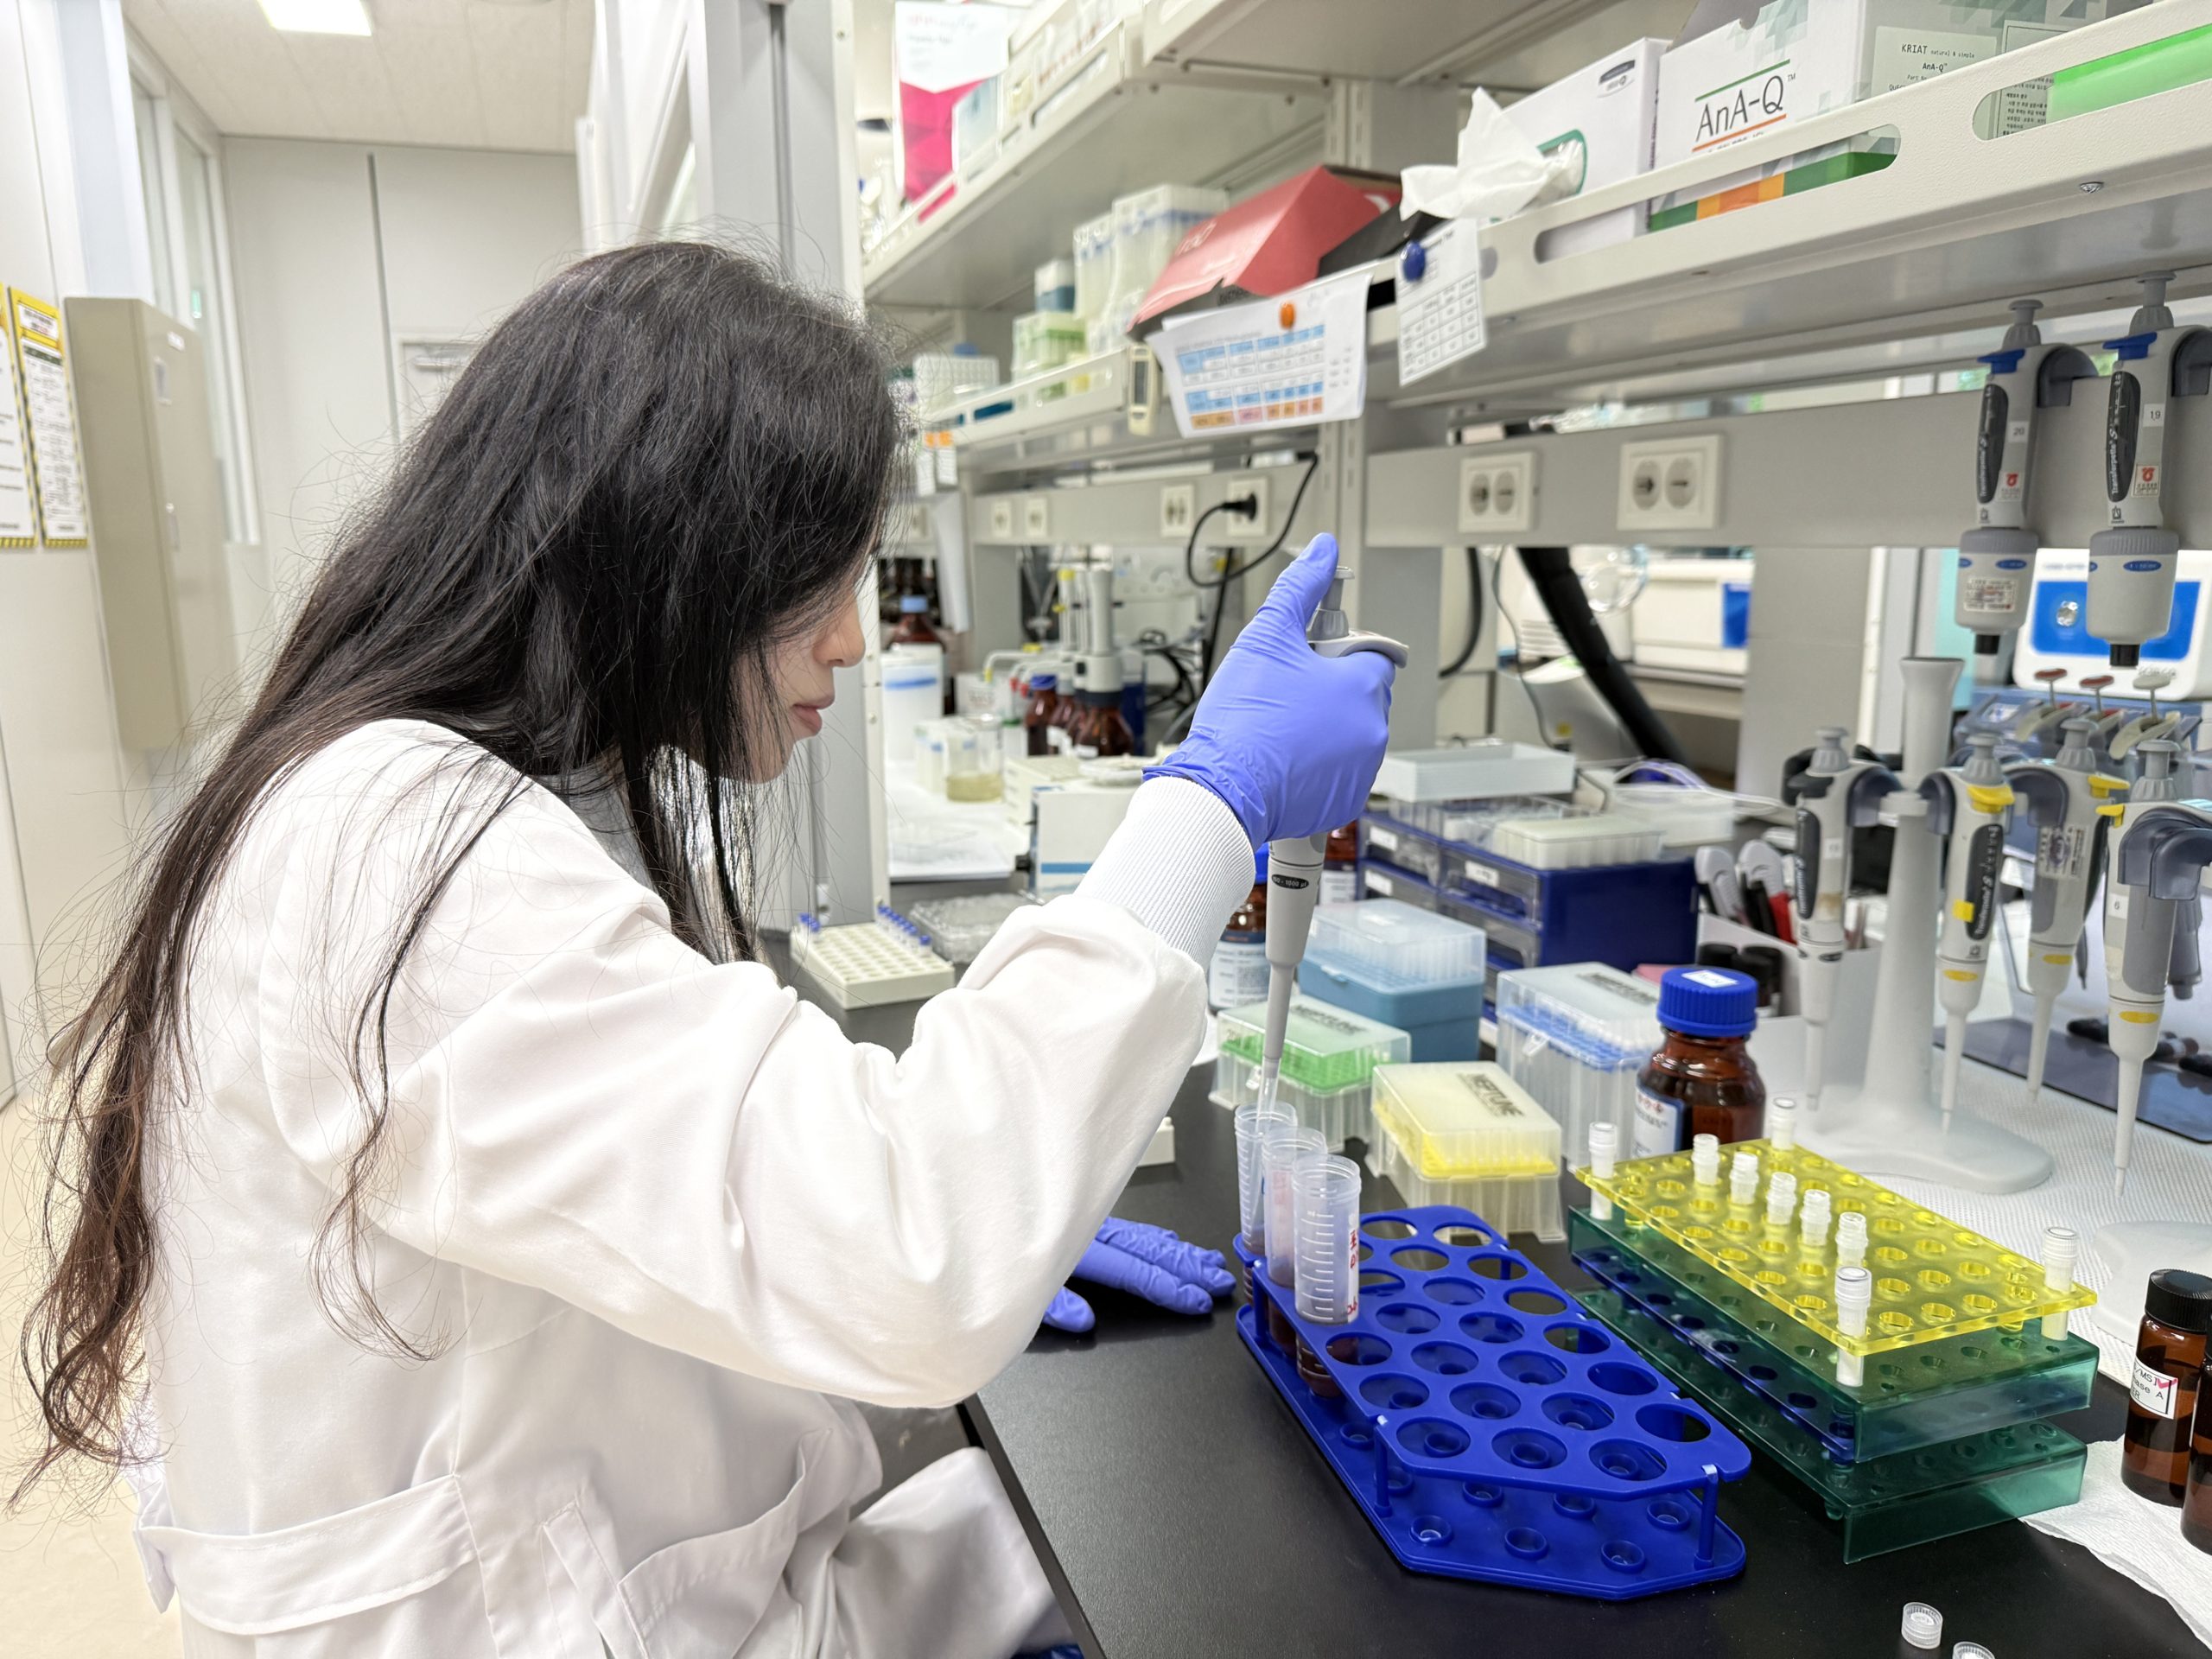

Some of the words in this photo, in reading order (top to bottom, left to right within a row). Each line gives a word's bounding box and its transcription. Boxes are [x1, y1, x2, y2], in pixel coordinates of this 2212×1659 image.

[1901, 44, 1928, 54] KRIAT
[1695, 75, 1784, 143] AnA-Q
[2151, 410, 2161, 421] 19
[2013, 427, 2024, 436] 20
[2156, 1391, 2164, 1400] A
